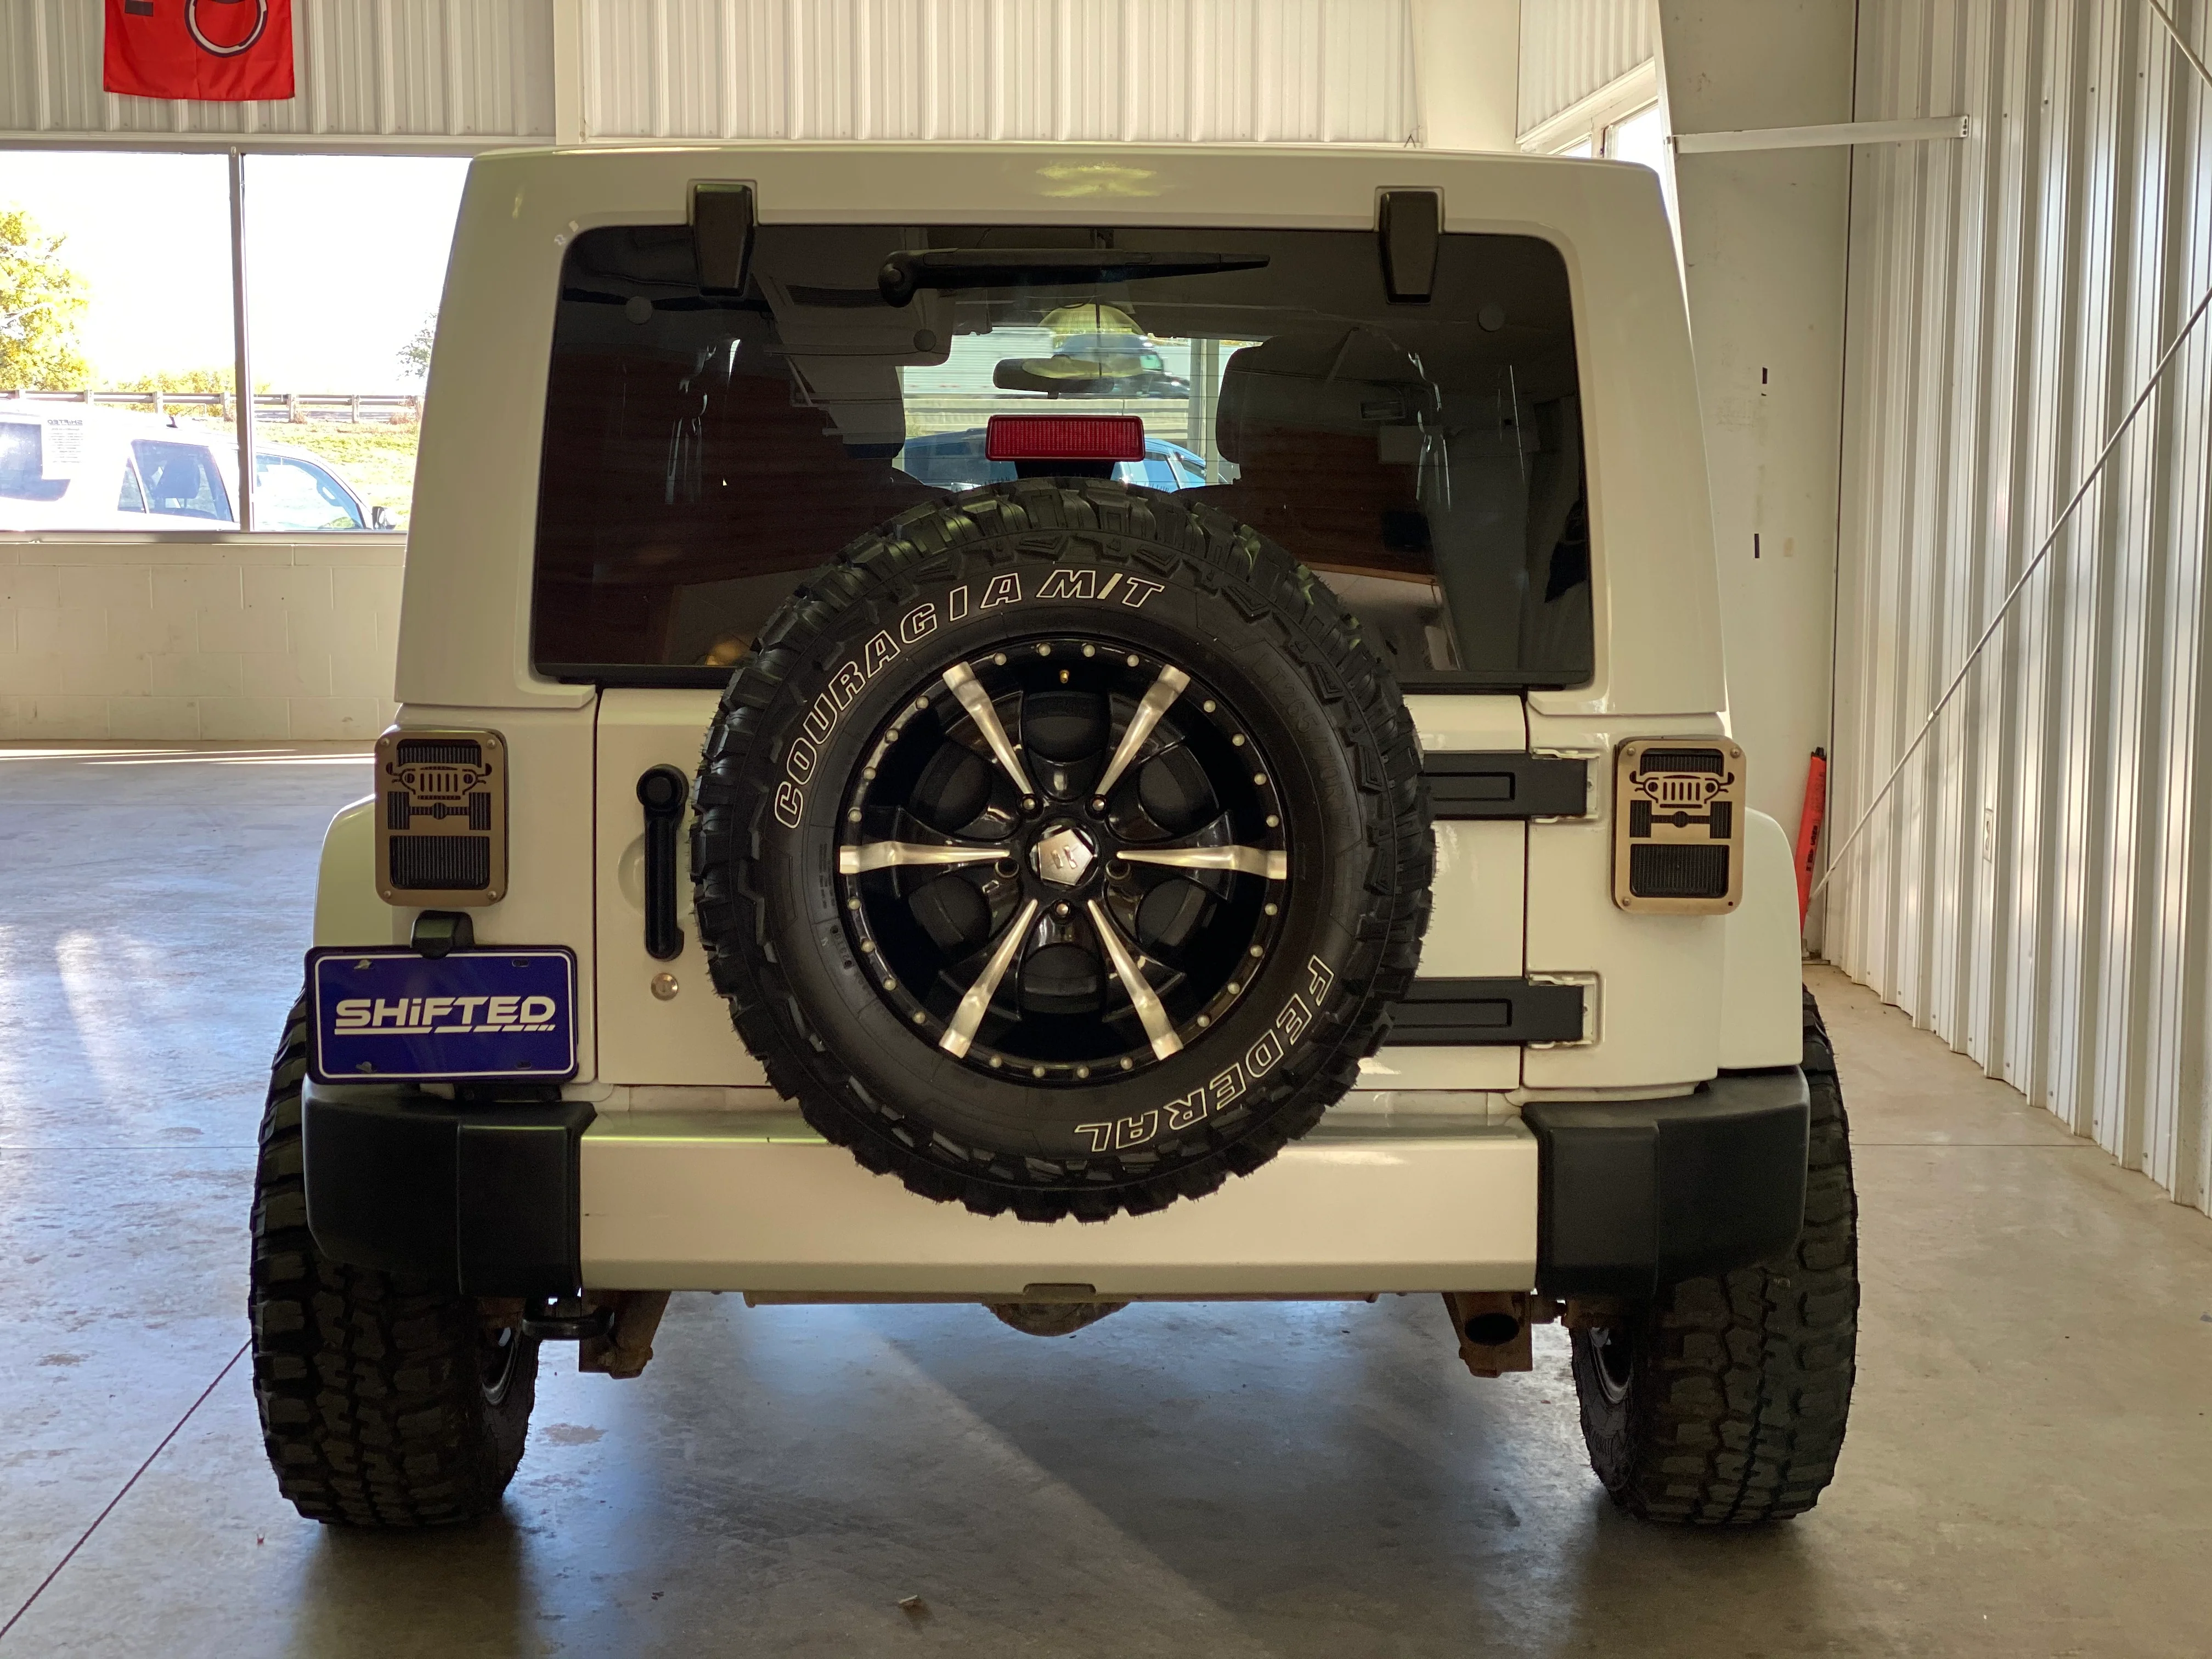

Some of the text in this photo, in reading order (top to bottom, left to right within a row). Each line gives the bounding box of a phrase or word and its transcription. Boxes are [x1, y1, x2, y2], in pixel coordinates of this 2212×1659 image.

[774, 569, 1165, 829] COURAGIA M/T
[1074, 954, 1335, 1152] FEDERAL
